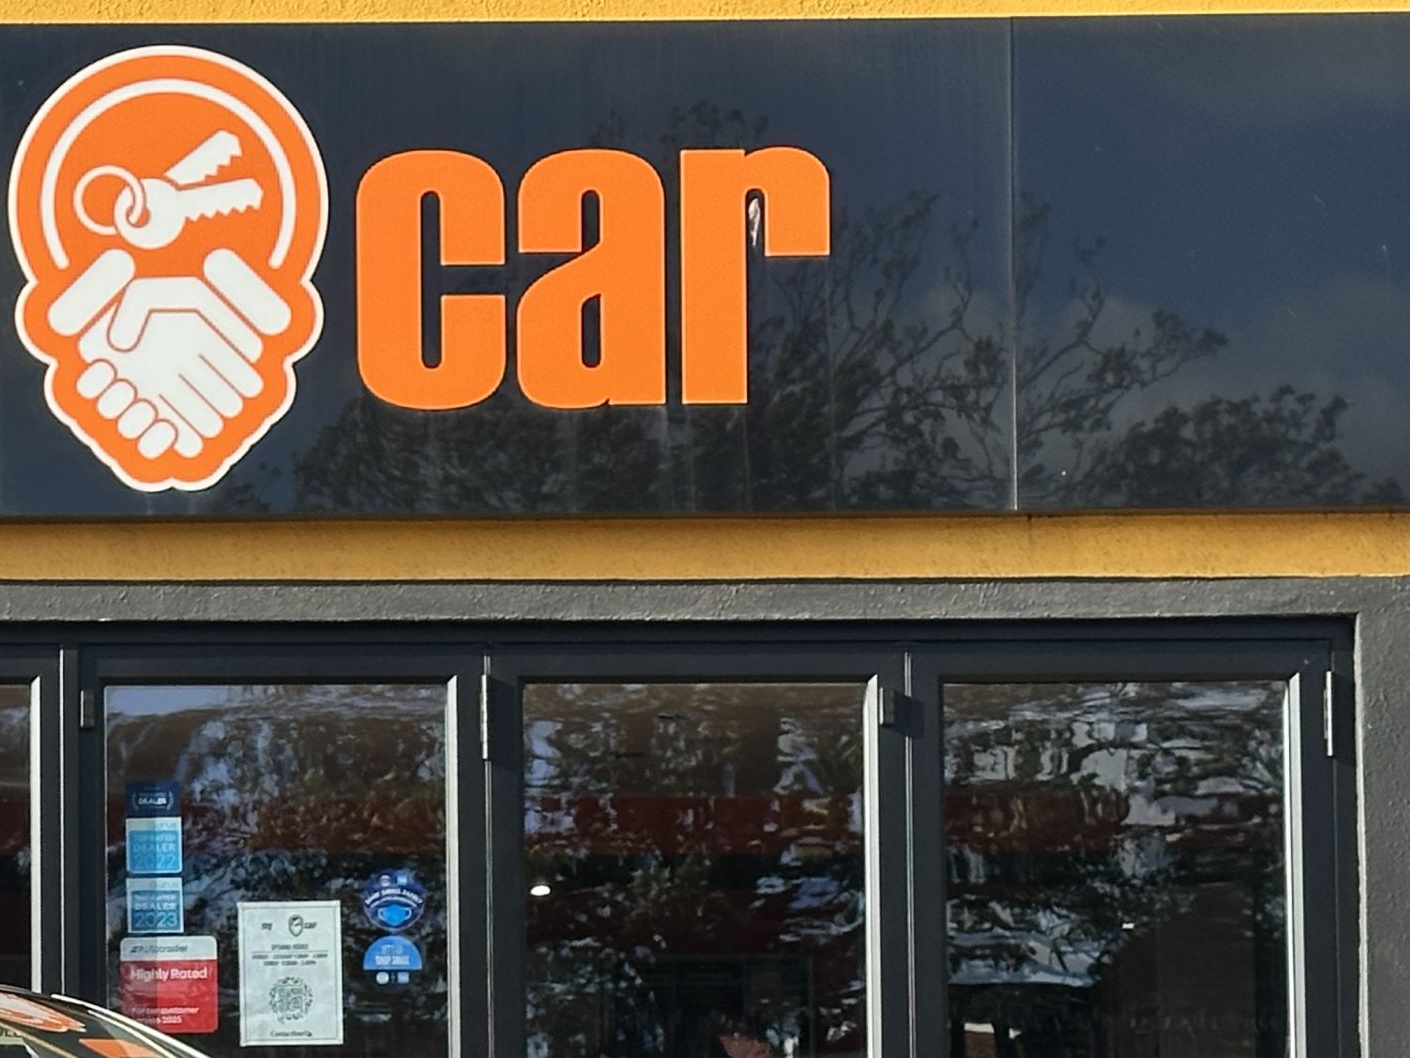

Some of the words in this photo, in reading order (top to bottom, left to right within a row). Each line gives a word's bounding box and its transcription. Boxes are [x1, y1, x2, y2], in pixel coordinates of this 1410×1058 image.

[355, 146, 831, 410] car
[133, 854, 176, 869] 2022
[134, 911, 178, 927] 2023
[131, 967, 170, 982] Highly
[170, 965, 208, 979] Rated
